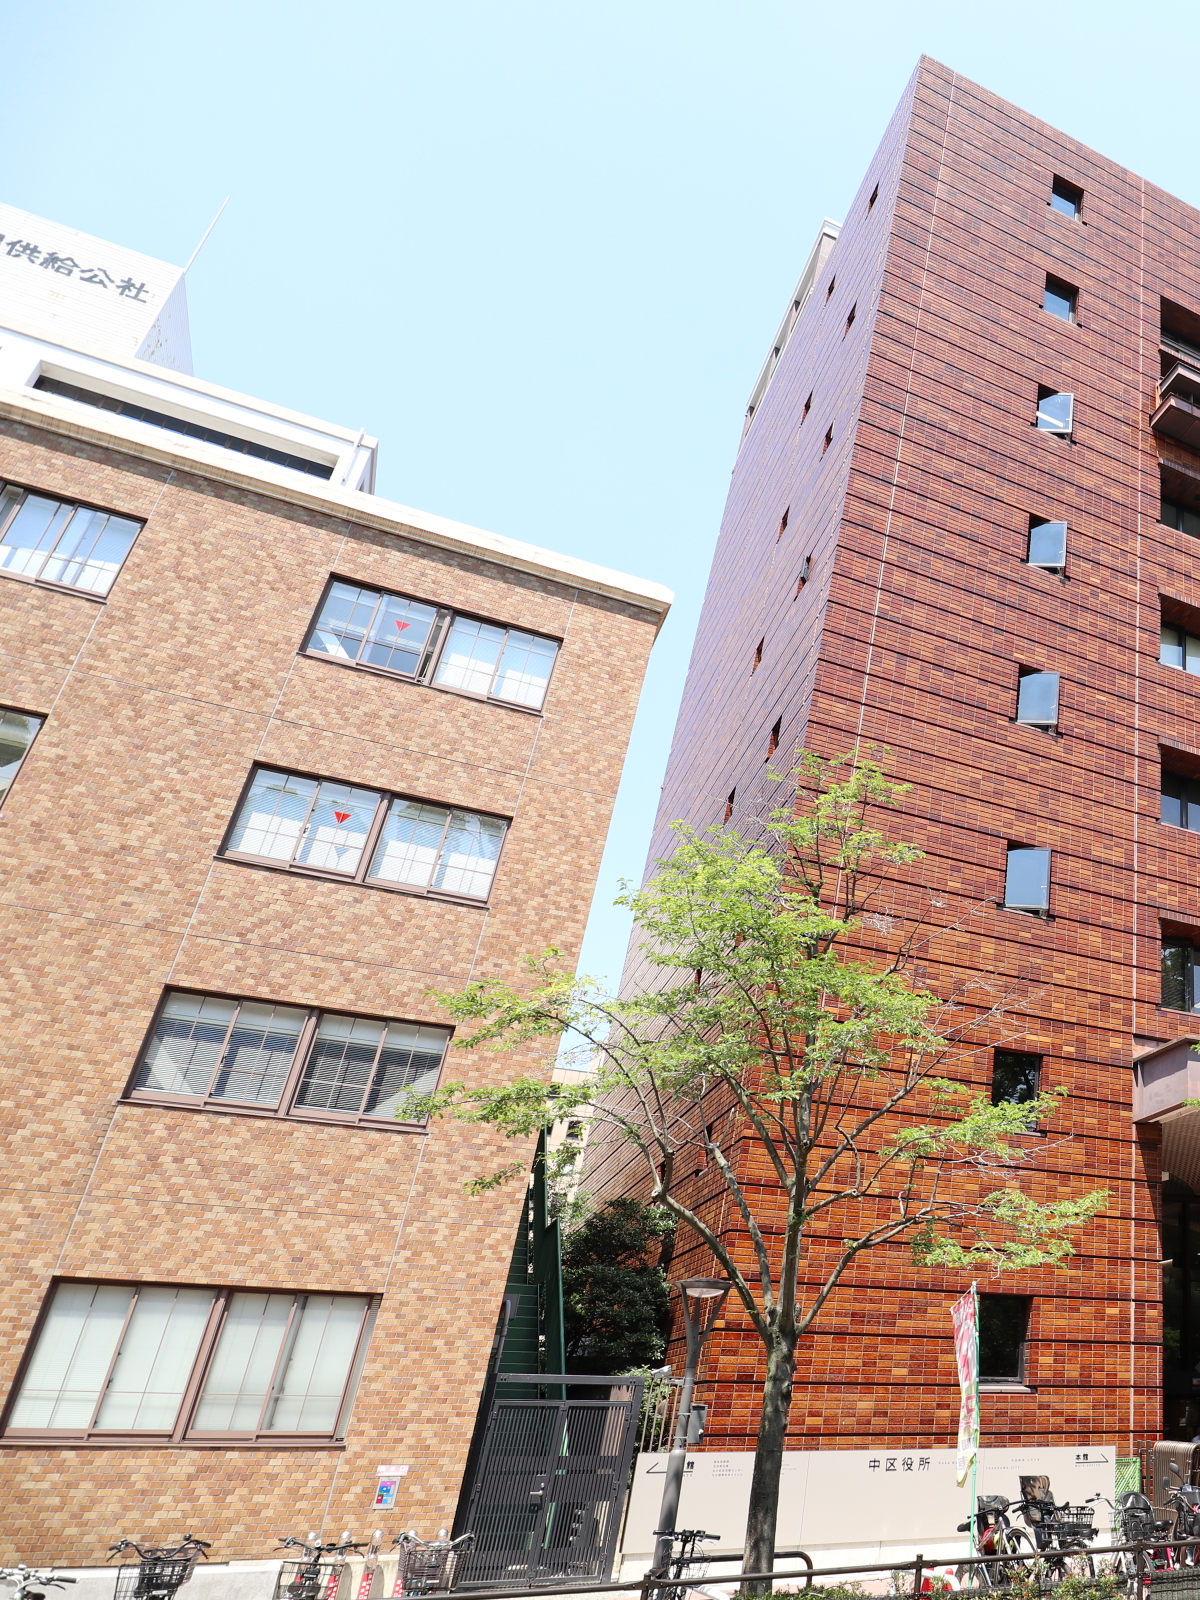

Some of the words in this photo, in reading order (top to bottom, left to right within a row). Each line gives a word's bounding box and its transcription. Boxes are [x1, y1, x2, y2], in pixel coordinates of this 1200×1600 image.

[0, 233, 149, 303] 供給公社
[868, 1457, 931, 1472] 中区役所
[1075, 1453, 1088, 1461] 本館
